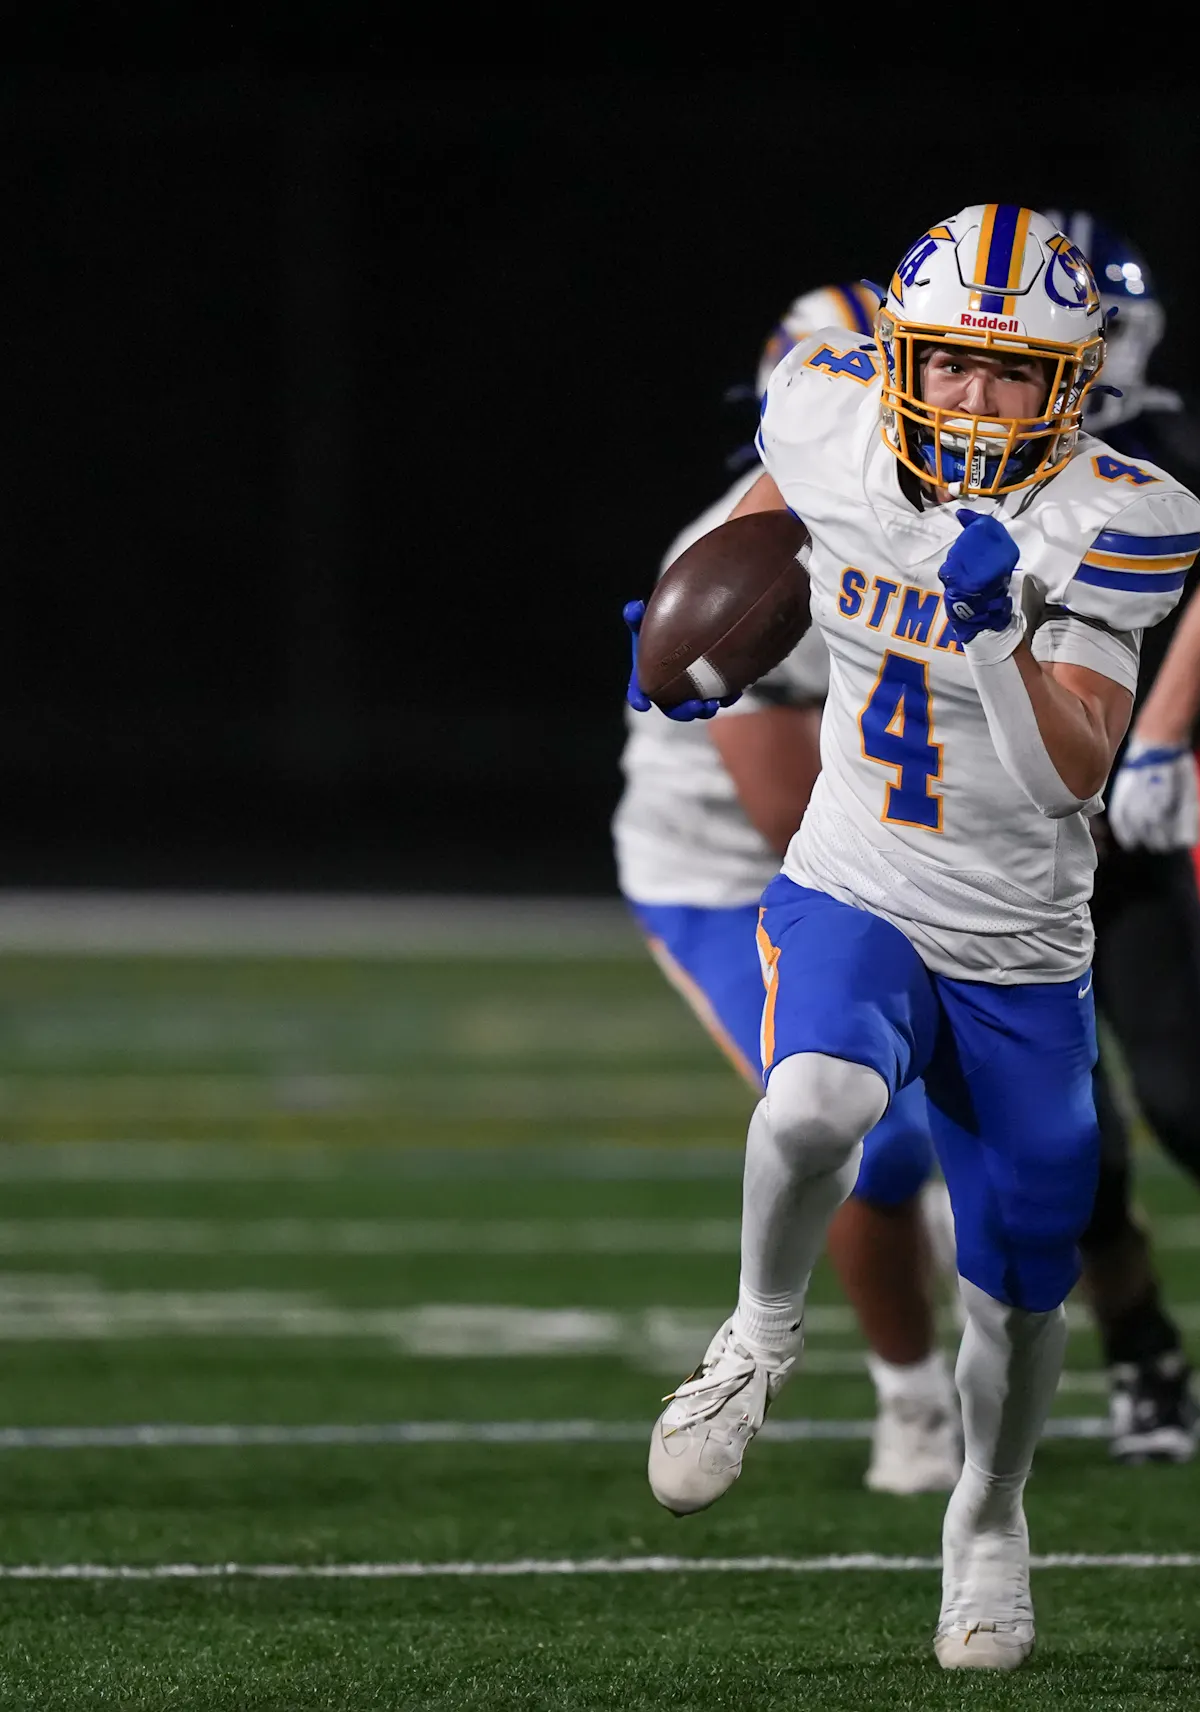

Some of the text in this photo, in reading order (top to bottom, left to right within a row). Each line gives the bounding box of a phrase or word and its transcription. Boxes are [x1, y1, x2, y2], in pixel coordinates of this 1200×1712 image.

[960, 313, 1019, 333] Riddell
[802, 343, 880, 388] 4
[1090, 454, 1164, 487] 4
[857, 649, 944, 834] 4
